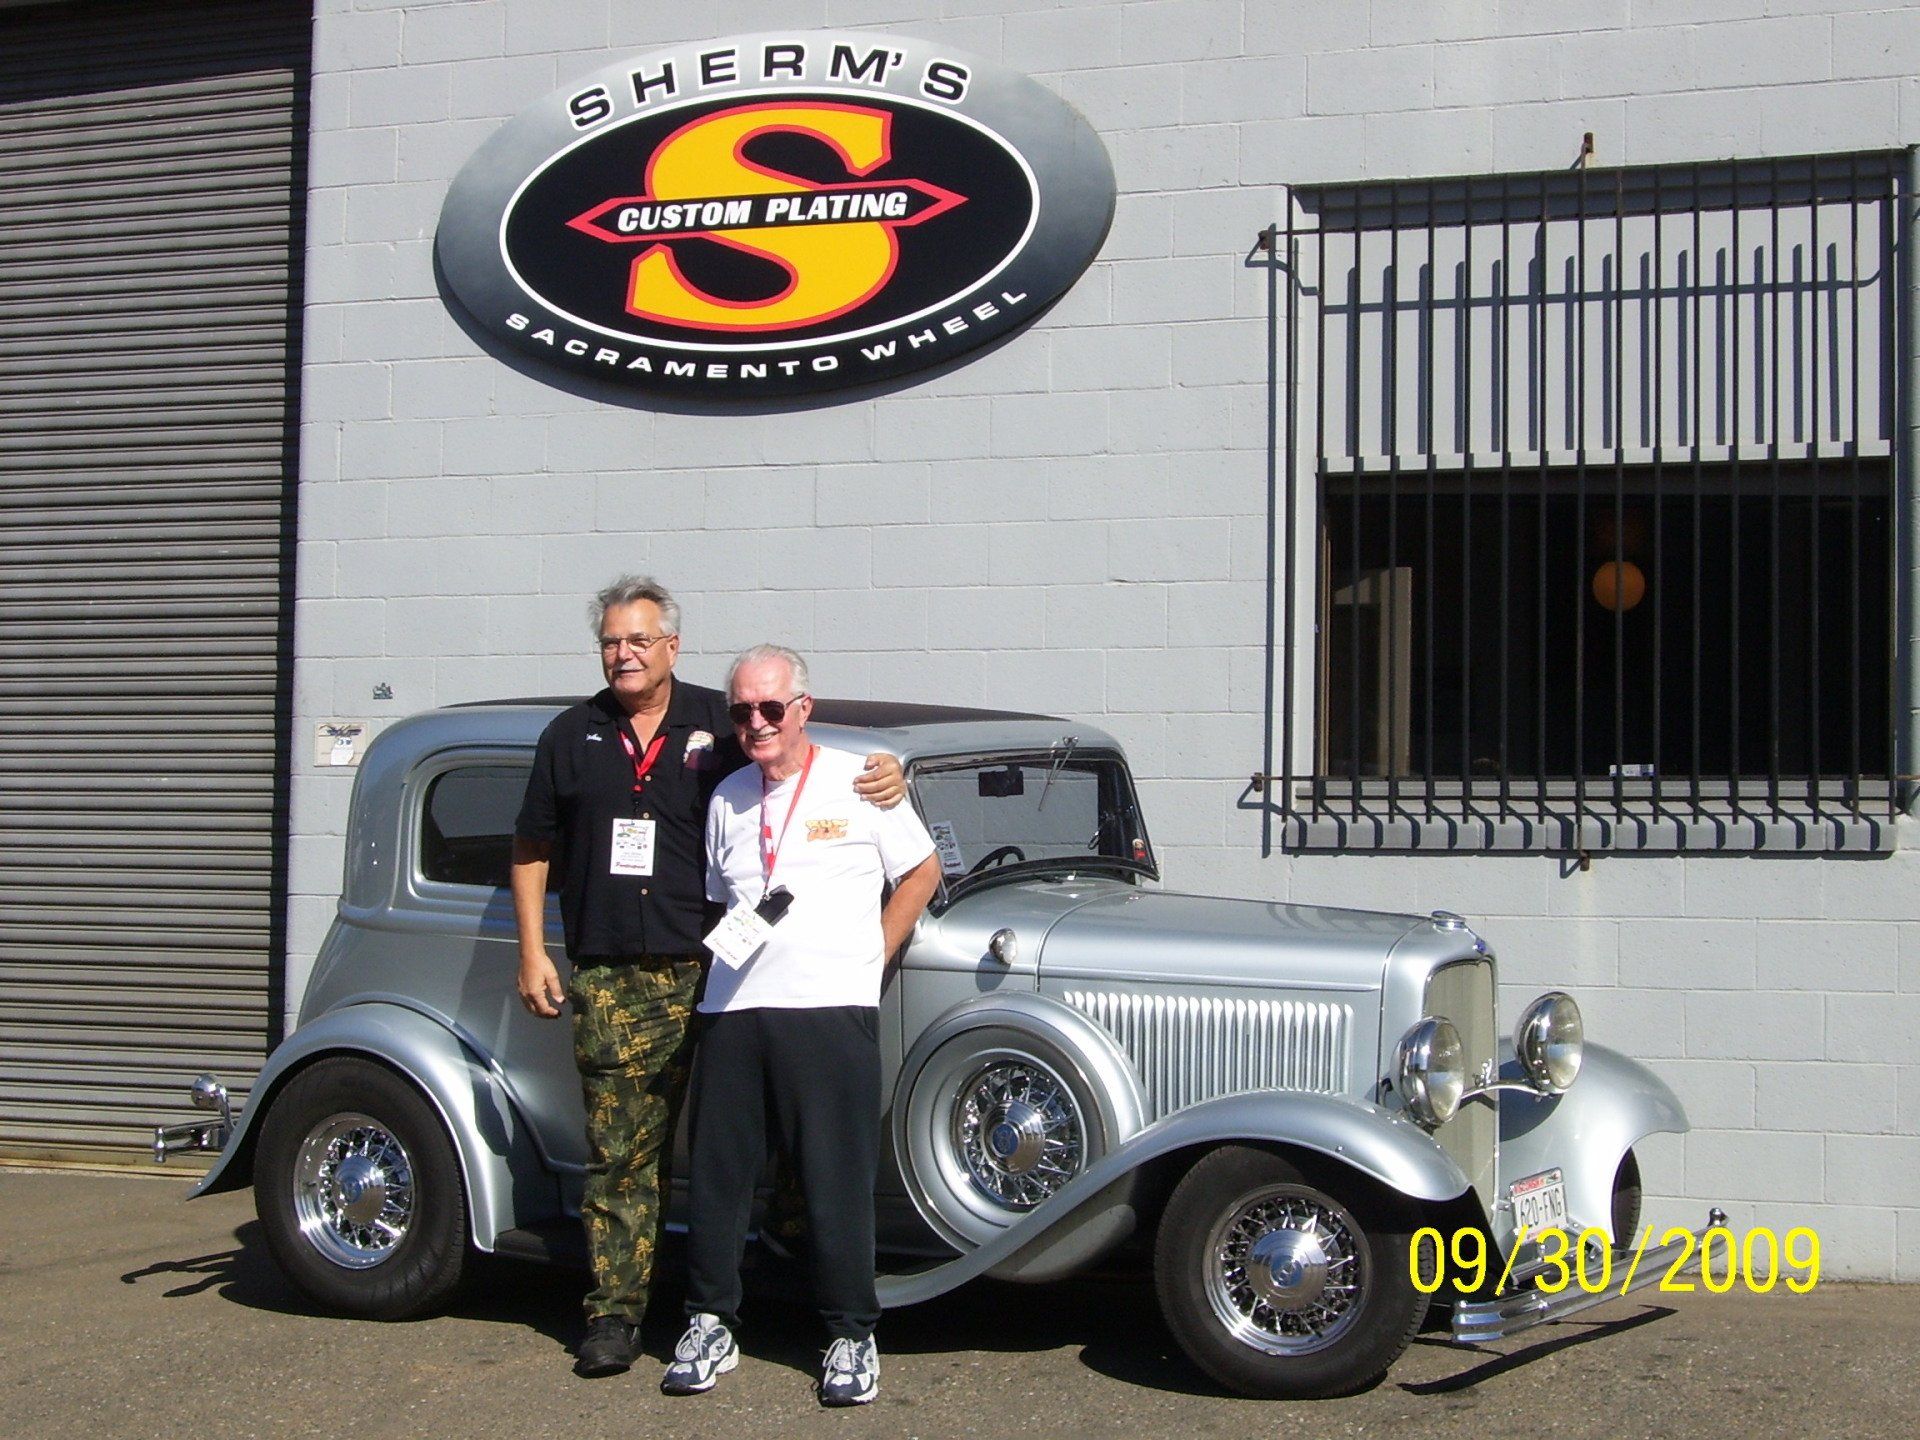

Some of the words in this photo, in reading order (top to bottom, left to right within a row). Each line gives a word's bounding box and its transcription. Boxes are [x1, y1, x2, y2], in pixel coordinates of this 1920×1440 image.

[569, 45, 968, 128] SHERM'S
[617, 199, 753, 232] CUSTOM
[765, 191, 908, 223] PLATING
[505, 313, 839, 379] SACRAMENTO
[860, 292, 1027, 361] WHEEL
